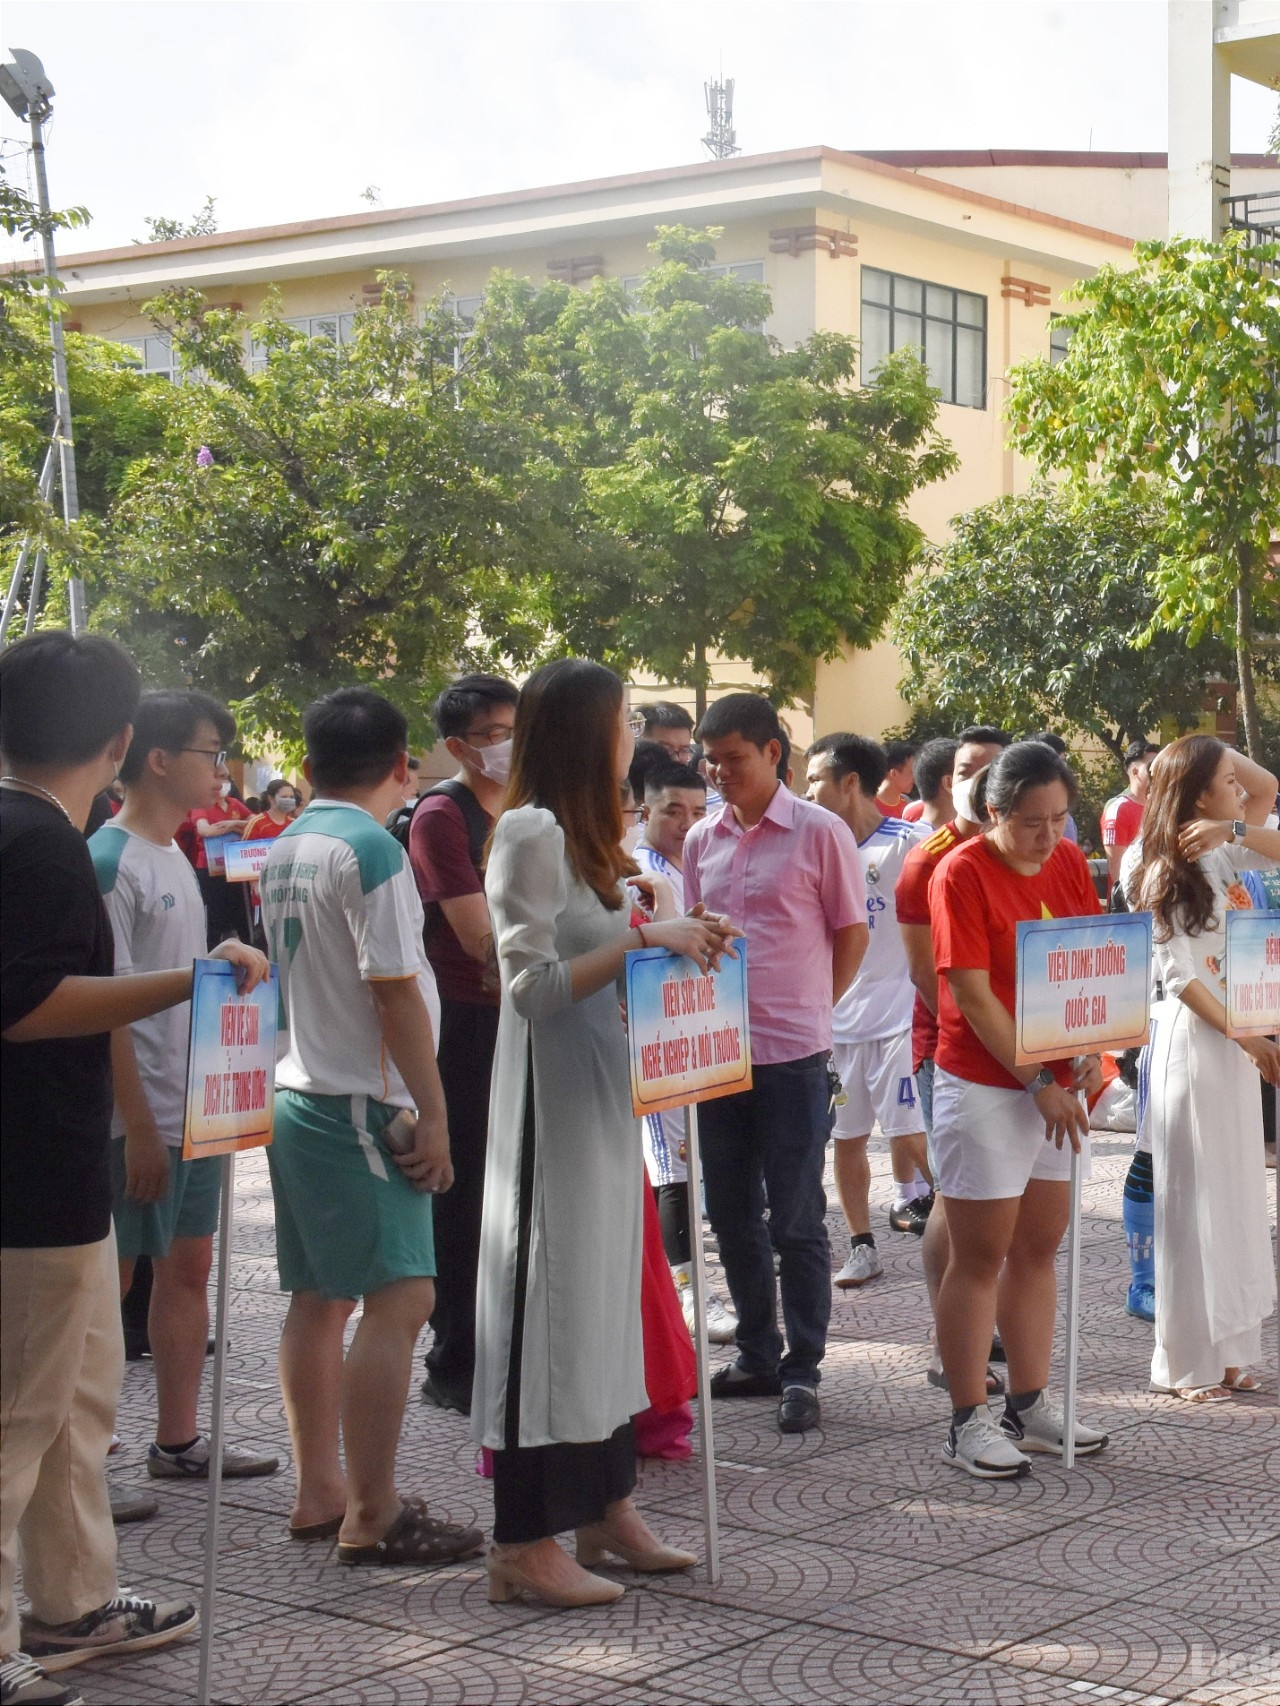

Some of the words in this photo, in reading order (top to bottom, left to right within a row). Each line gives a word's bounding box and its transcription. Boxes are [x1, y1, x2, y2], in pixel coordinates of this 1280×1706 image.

[1048, 945, 1069, 989] VIỆN
[1071, 948, 1093, 980] DINH
[1095, 940, 1126, 977] DƯỠNG
[662, 974, 680, 1026] VIỆN
[681, 973, 695, 1016] SỨC
[1064, 987, 1089, 1032] QUỐC
[1091, 995, 1107, 1026] GIA
[663, 1031, 690, 1081] NGHIỆP
[691, 1036, 698, 1070] &
[698, 1026, 713, 1068] MÔI
[712, 1020, 741, 1065] TRƯỜNG
[898, 1077, 916, 1109] 4
